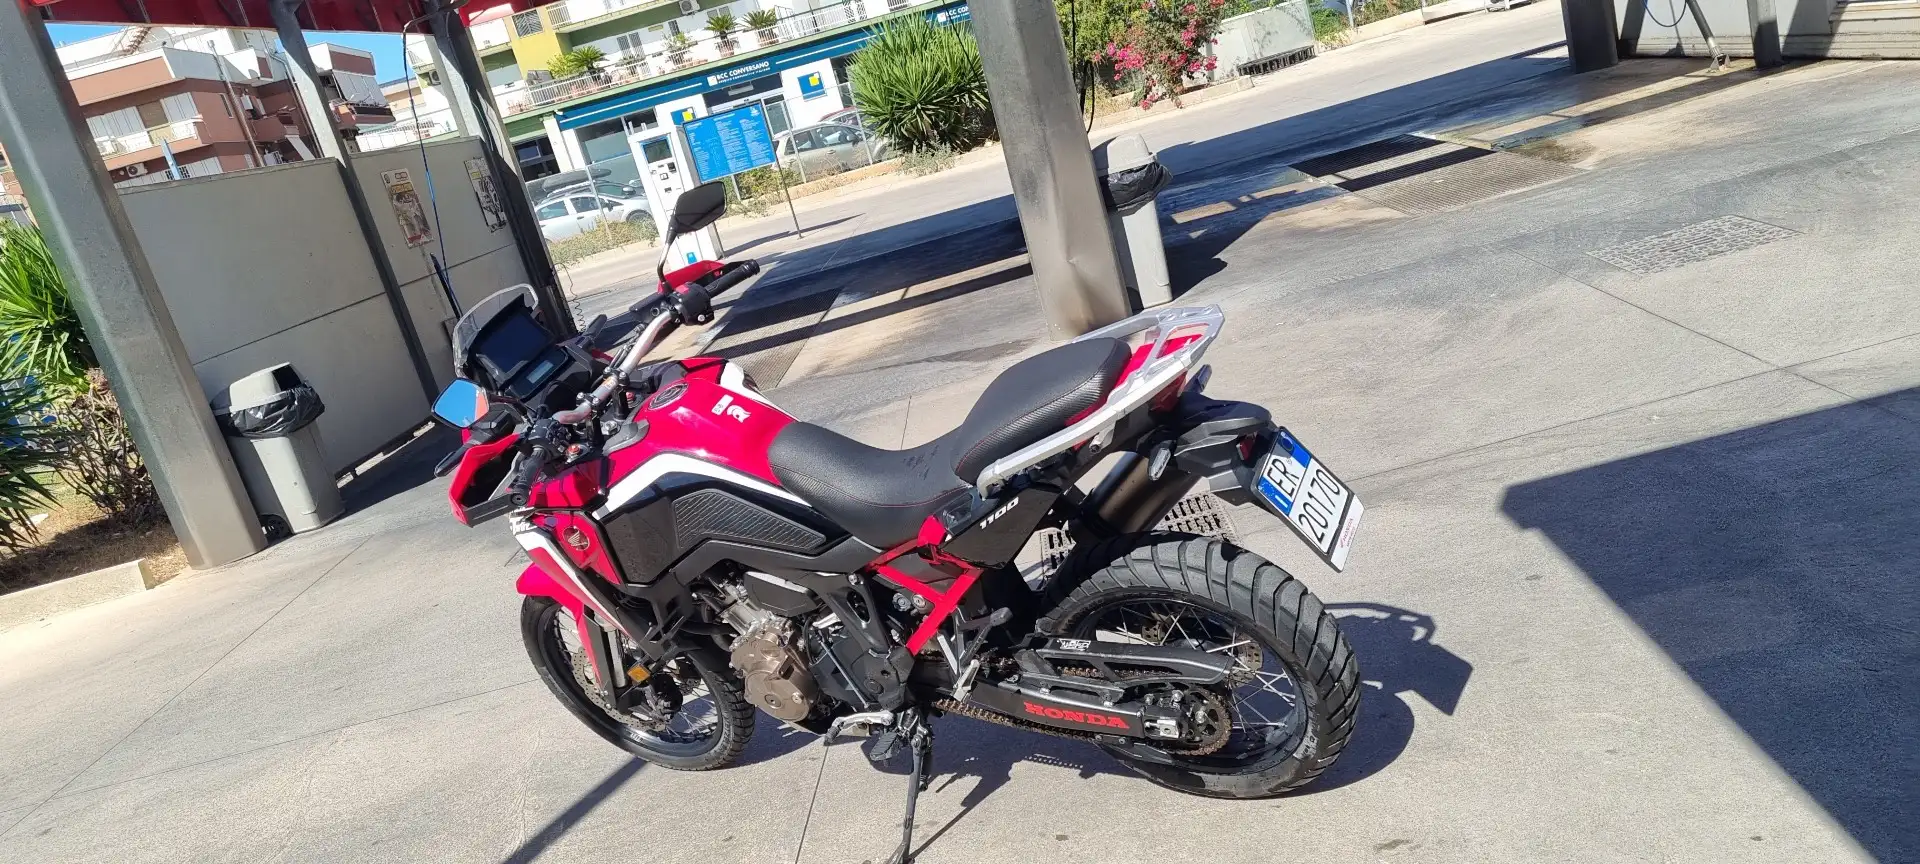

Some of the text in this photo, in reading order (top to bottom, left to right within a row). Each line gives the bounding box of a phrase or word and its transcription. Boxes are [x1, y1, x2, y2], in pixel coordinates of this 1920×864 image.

[716, 72, 729, 80] BCC
[729, 61, 770, 77] CONVERSANO
[1267, 459, 1300, 497] ER
[980, 497, 1019, 529] 1100
[1298, 468, 1341, 544] 20170
[1024, 702, 1130, 729] HONDA
